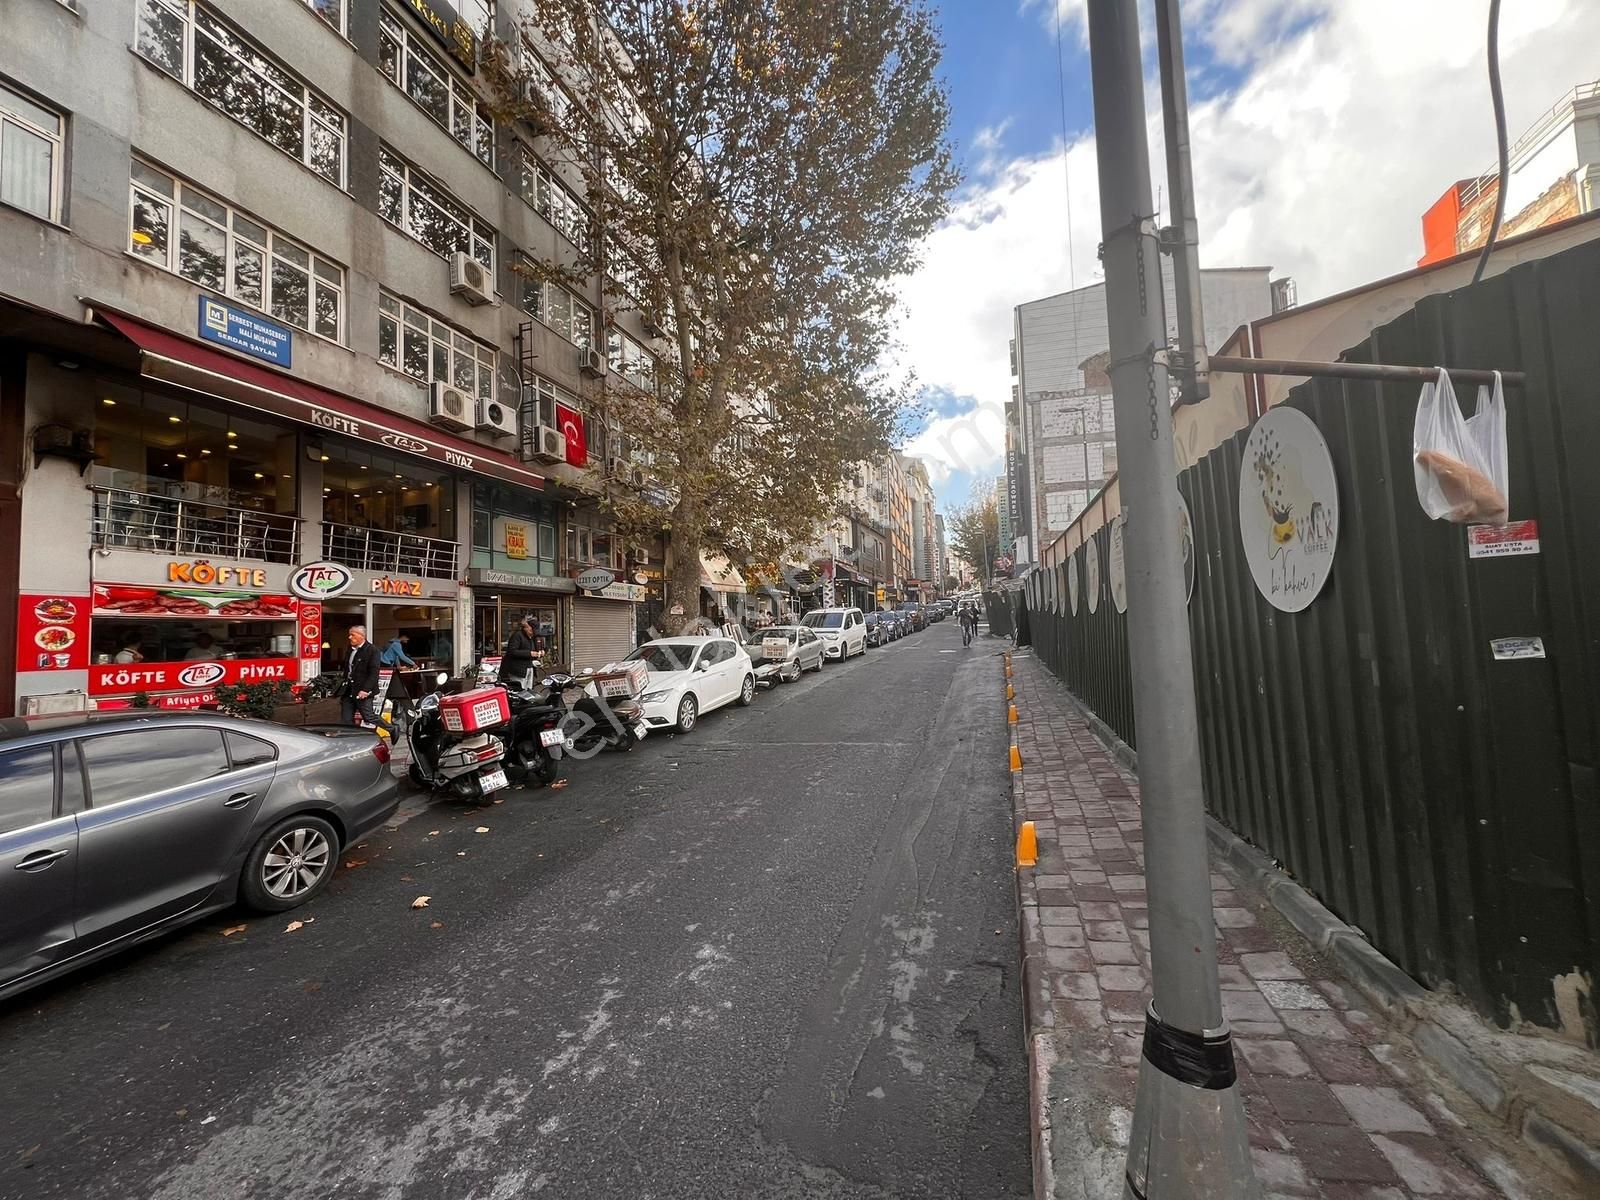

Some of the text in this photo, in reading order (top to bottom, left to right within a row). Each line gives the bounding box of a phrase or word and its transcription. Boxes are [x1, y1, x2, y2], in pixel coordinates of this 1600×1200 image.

[228, 313, 253, 328] SERBEST
[217, 332, 278, 358] SERDAR ŞAYLAN
[311, 409, 359, 436] KÖFTE
[445, 451, 474, 470] PİYAZ
[168, 559, 423, 597] KÖFTE TAT PİYAZ
[101, 664, 285, 686] KÖFTE TAT PİYAZ
[166, 695, 200, 706] Afiyet
